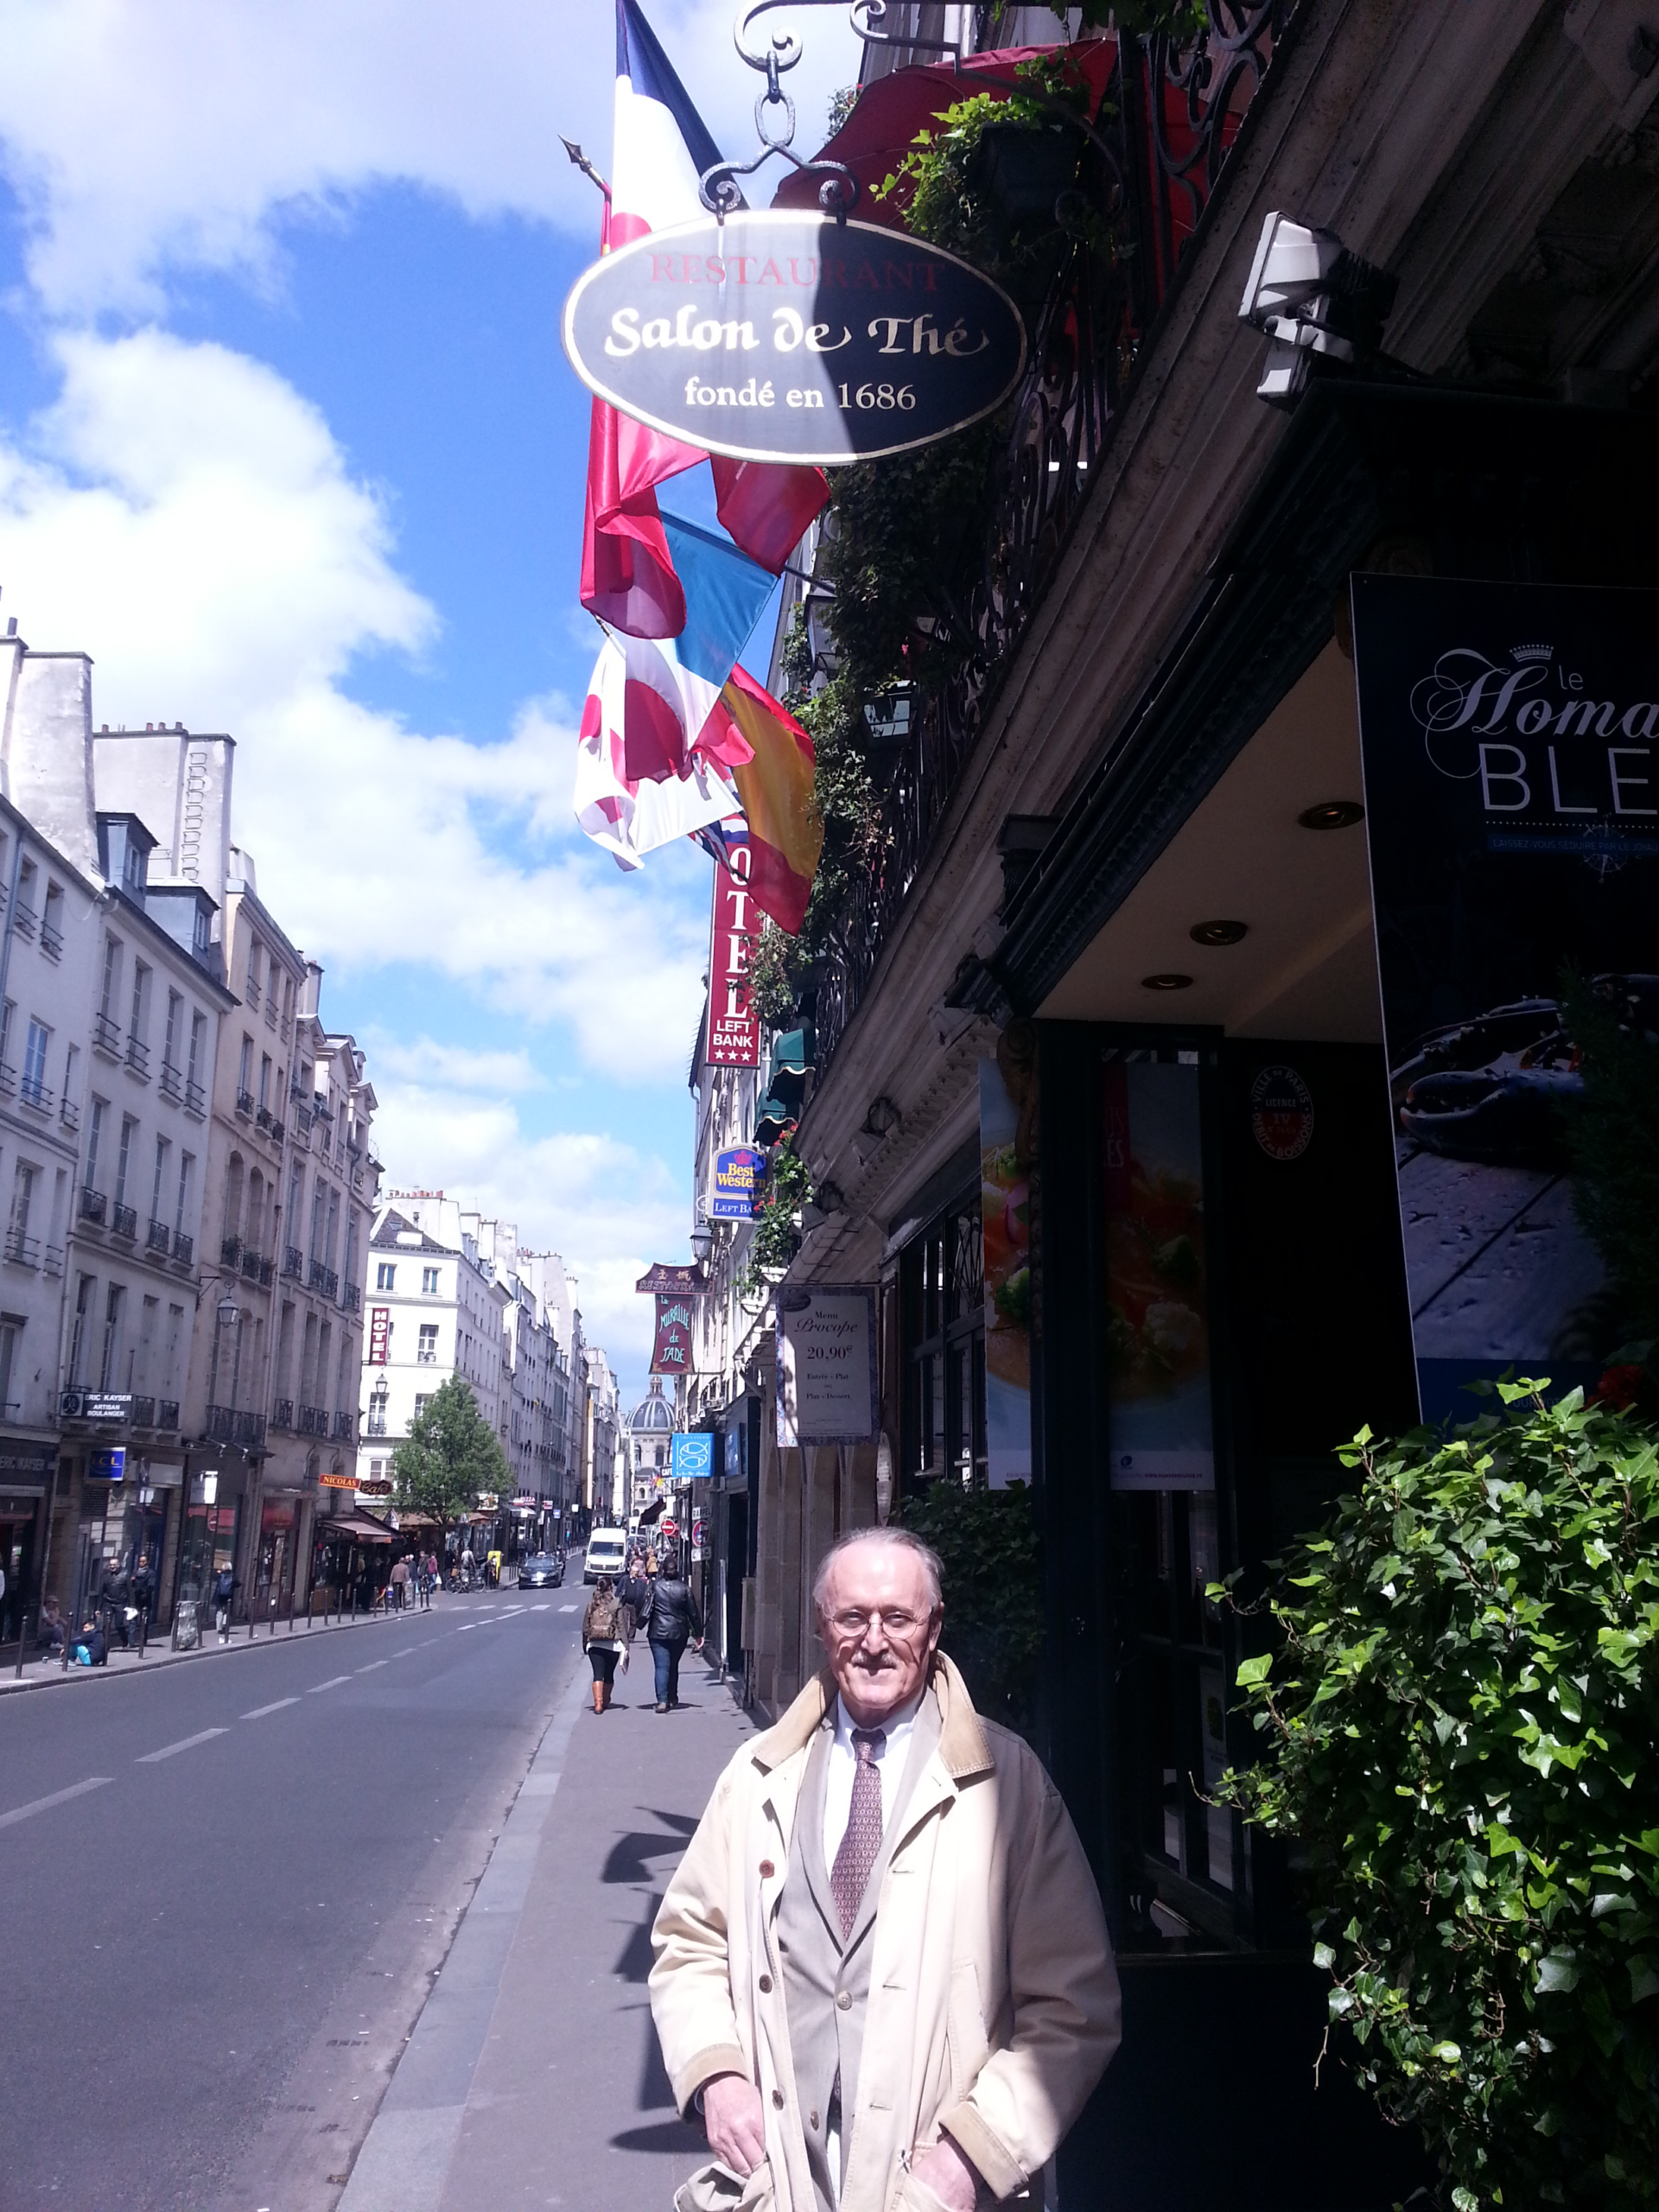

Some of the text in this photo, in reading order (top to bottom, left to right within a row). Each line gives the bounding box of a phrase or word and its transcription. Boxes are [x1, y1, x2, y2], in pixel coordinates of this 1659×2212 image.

[649, 253, 946, 291] RESTAURANT
[607, 304, 990, 357] Salon de Thé
[683, 376, 917, 410] fondé en 1686
[1558, 664, 1585, 690] le
[1478, 743, 1659, 815] BLE
[1493, 838, 1556, 849] LAISSEZ-VOUS
[1599, 842, 1617, 851] PAR
[1618, 842, 1629, 851] LE
[723, 848, 754, 1019] OTEL
[716, 1020, 752, 1033] LEFT
[713, 1033, 753, 1048] BANK
[1252, 1072, 1273, 1103] VILLE
[1285, 1071, 1310, 1104] PARIS
[1265, 1098, 1297, 1108] LICENCE
[1272, 1113, 1292, 1125] IV
[1276, 1113, 1313, 1158] BOISSONS
[728, 1163, 757, 1177] Best
[717, 1173, 766, 1188] Western
[715, 1202, 739, 1213] LEFT
[815, 1311, 838, 1319] Menu
[793, 1318, 858, 1338] Procope
[372, 1311, 388, 1362] HOTEL
[660, 1347, 685, 1363] JADE
[323, 1476, 357, 1487] NICOLAS
